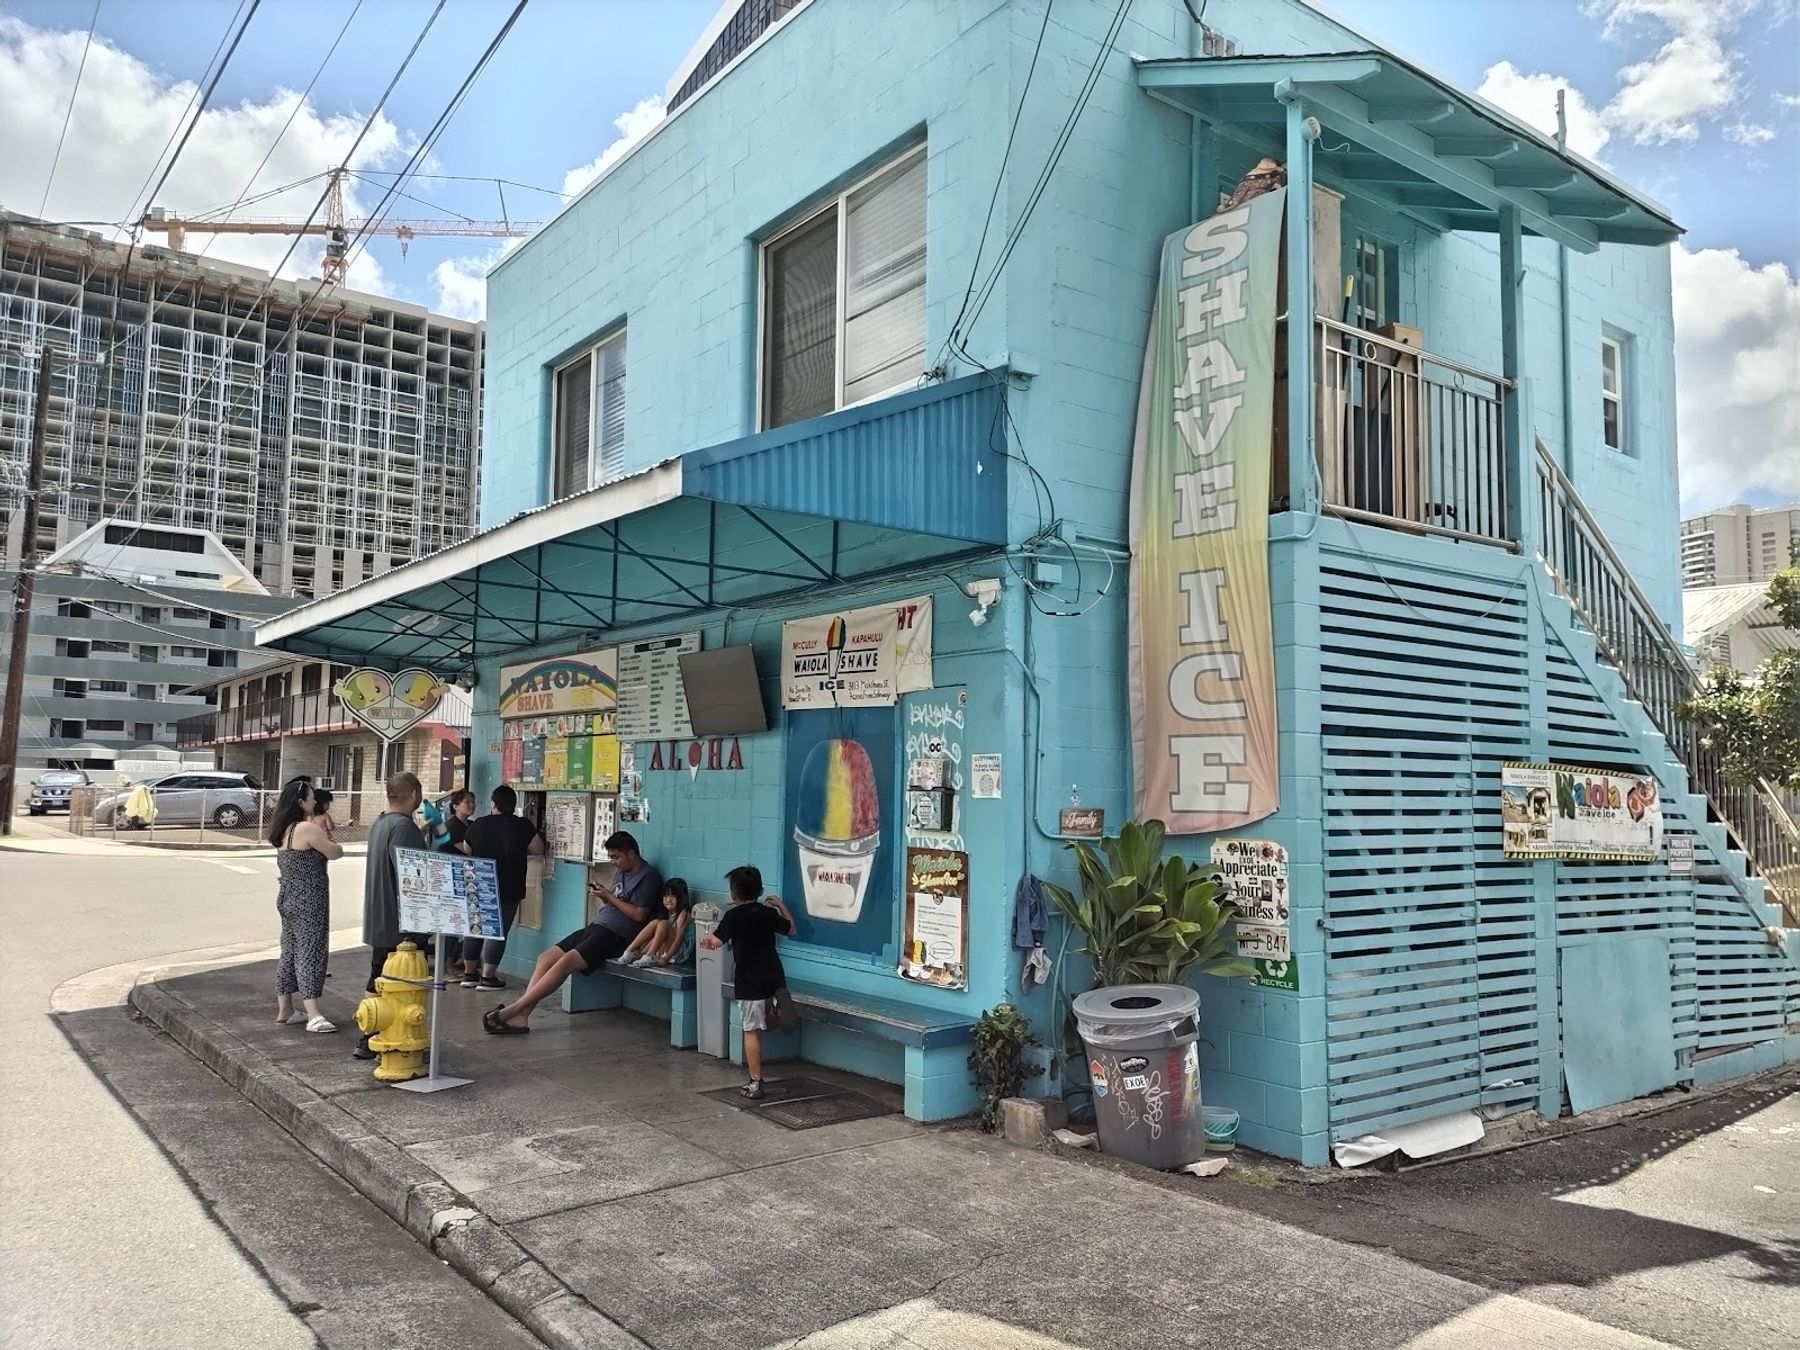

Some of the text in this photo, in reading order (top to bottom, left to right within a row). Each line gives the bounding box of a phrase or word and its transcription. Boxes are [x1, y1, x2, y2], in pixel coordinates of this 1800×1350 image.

[1167, 205, 1252, 815] SHAVE ICE
[792, 632, 884, 651] McCULLY KAPAHULU
[794, 652, 878, 673] WAIOLA SHAVE
[510, 664, 603, 695] WAIOLA
[819, 680, 845, 691] ICE
[517, 687, 594, 713] SHAVE ICE
[649, 738, 744, 771] ALOHA
[1555, 771, 1621, 819] Waiola
[1238, 842, 1255, 857] We
[1220, 858, 1278, 878] Appreciate
[1234, 880, 1262, 897] Your
[1244, 905, 1274, 920] iness
[1266, 934, 1287, 953] 847
[1260, 978, 1294, 989] RECYCLE
[1125, 1076, 1146, 1088] EXOE
